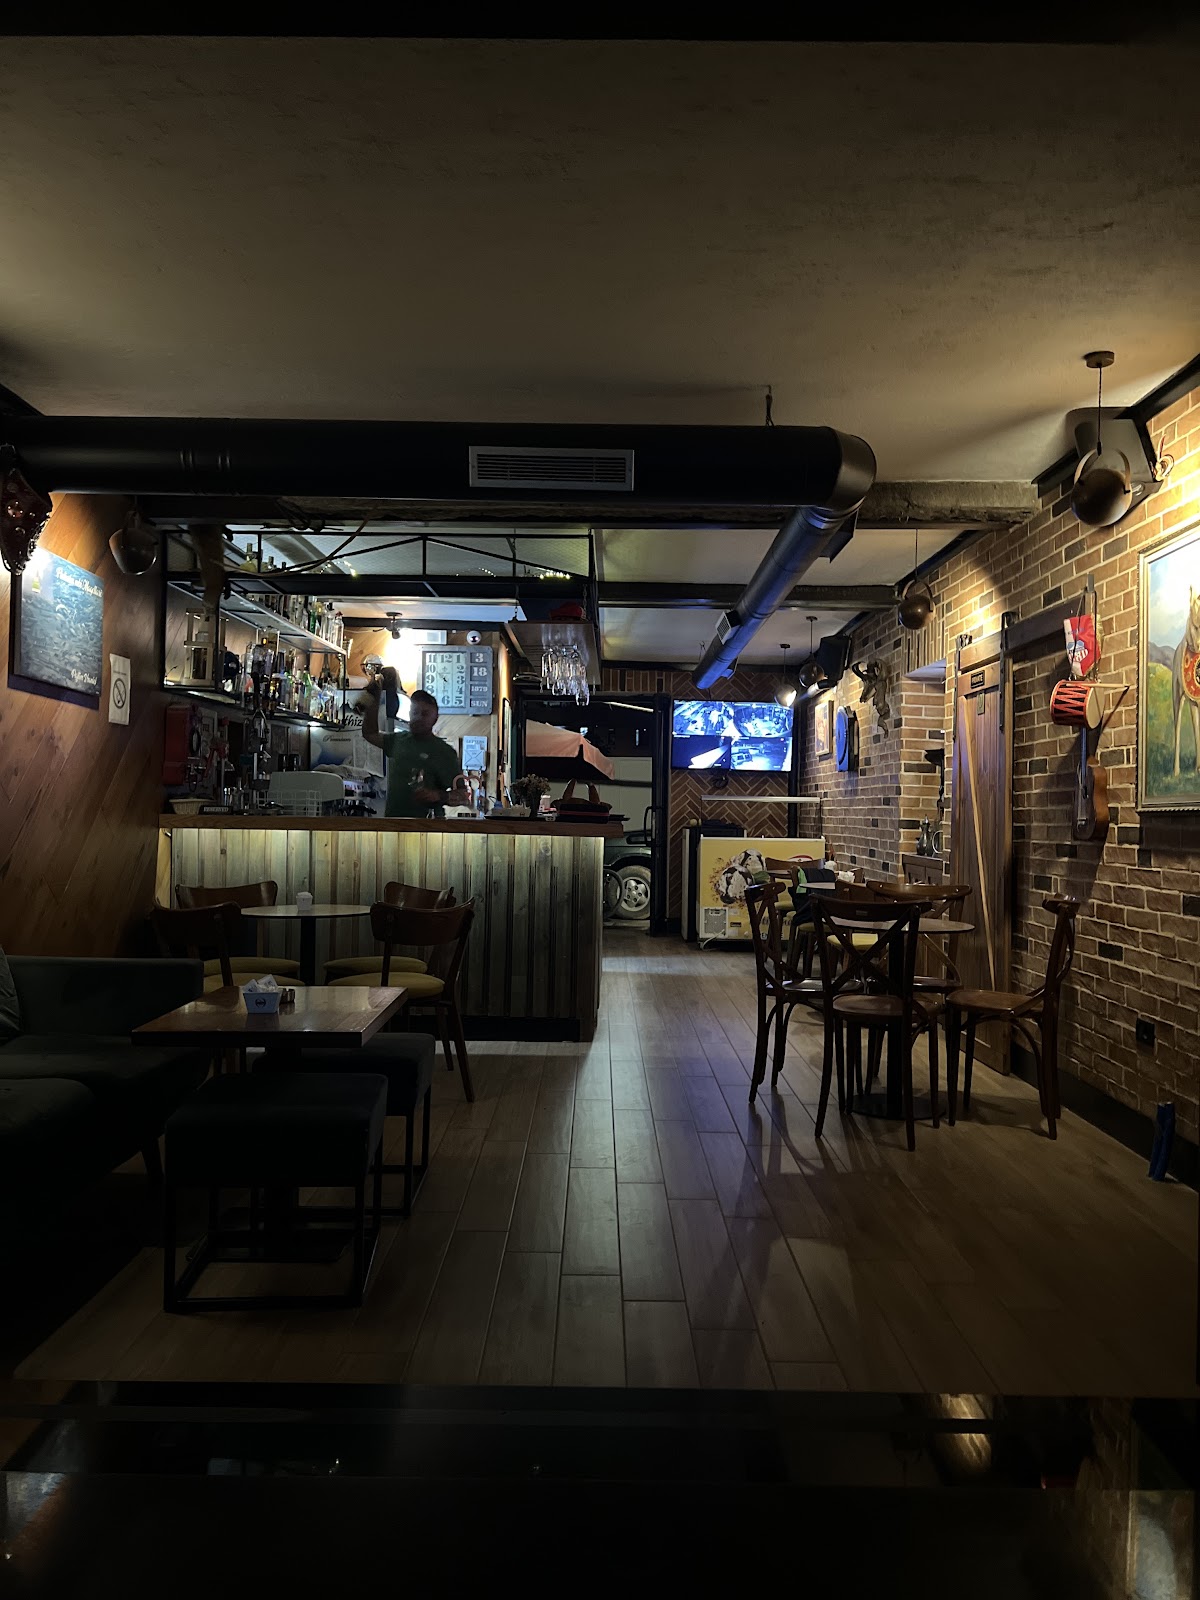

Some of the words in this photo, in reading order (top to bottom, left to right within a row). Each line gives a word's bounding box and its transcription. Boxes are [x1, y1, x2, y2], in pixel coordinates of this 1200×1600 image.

[429, 654, 437, 663] 11
[440, 654, 453, 663] 12
[456, 654, 461, 663] 1
[475, 653, 484, 662] 3
[427, 664, 436, 673] 10
[457, 665, 465, 674] 2
[473, 667, 488, 677] 18
[426, 674, 435, 684] 9
[457, 676, 465, 685] 3
[456, 686, 465, 695] 4
[441, 695, 451, 705] 6
[454, 696, 463, 705] 5
[471, 700, 488, 708] SUN
